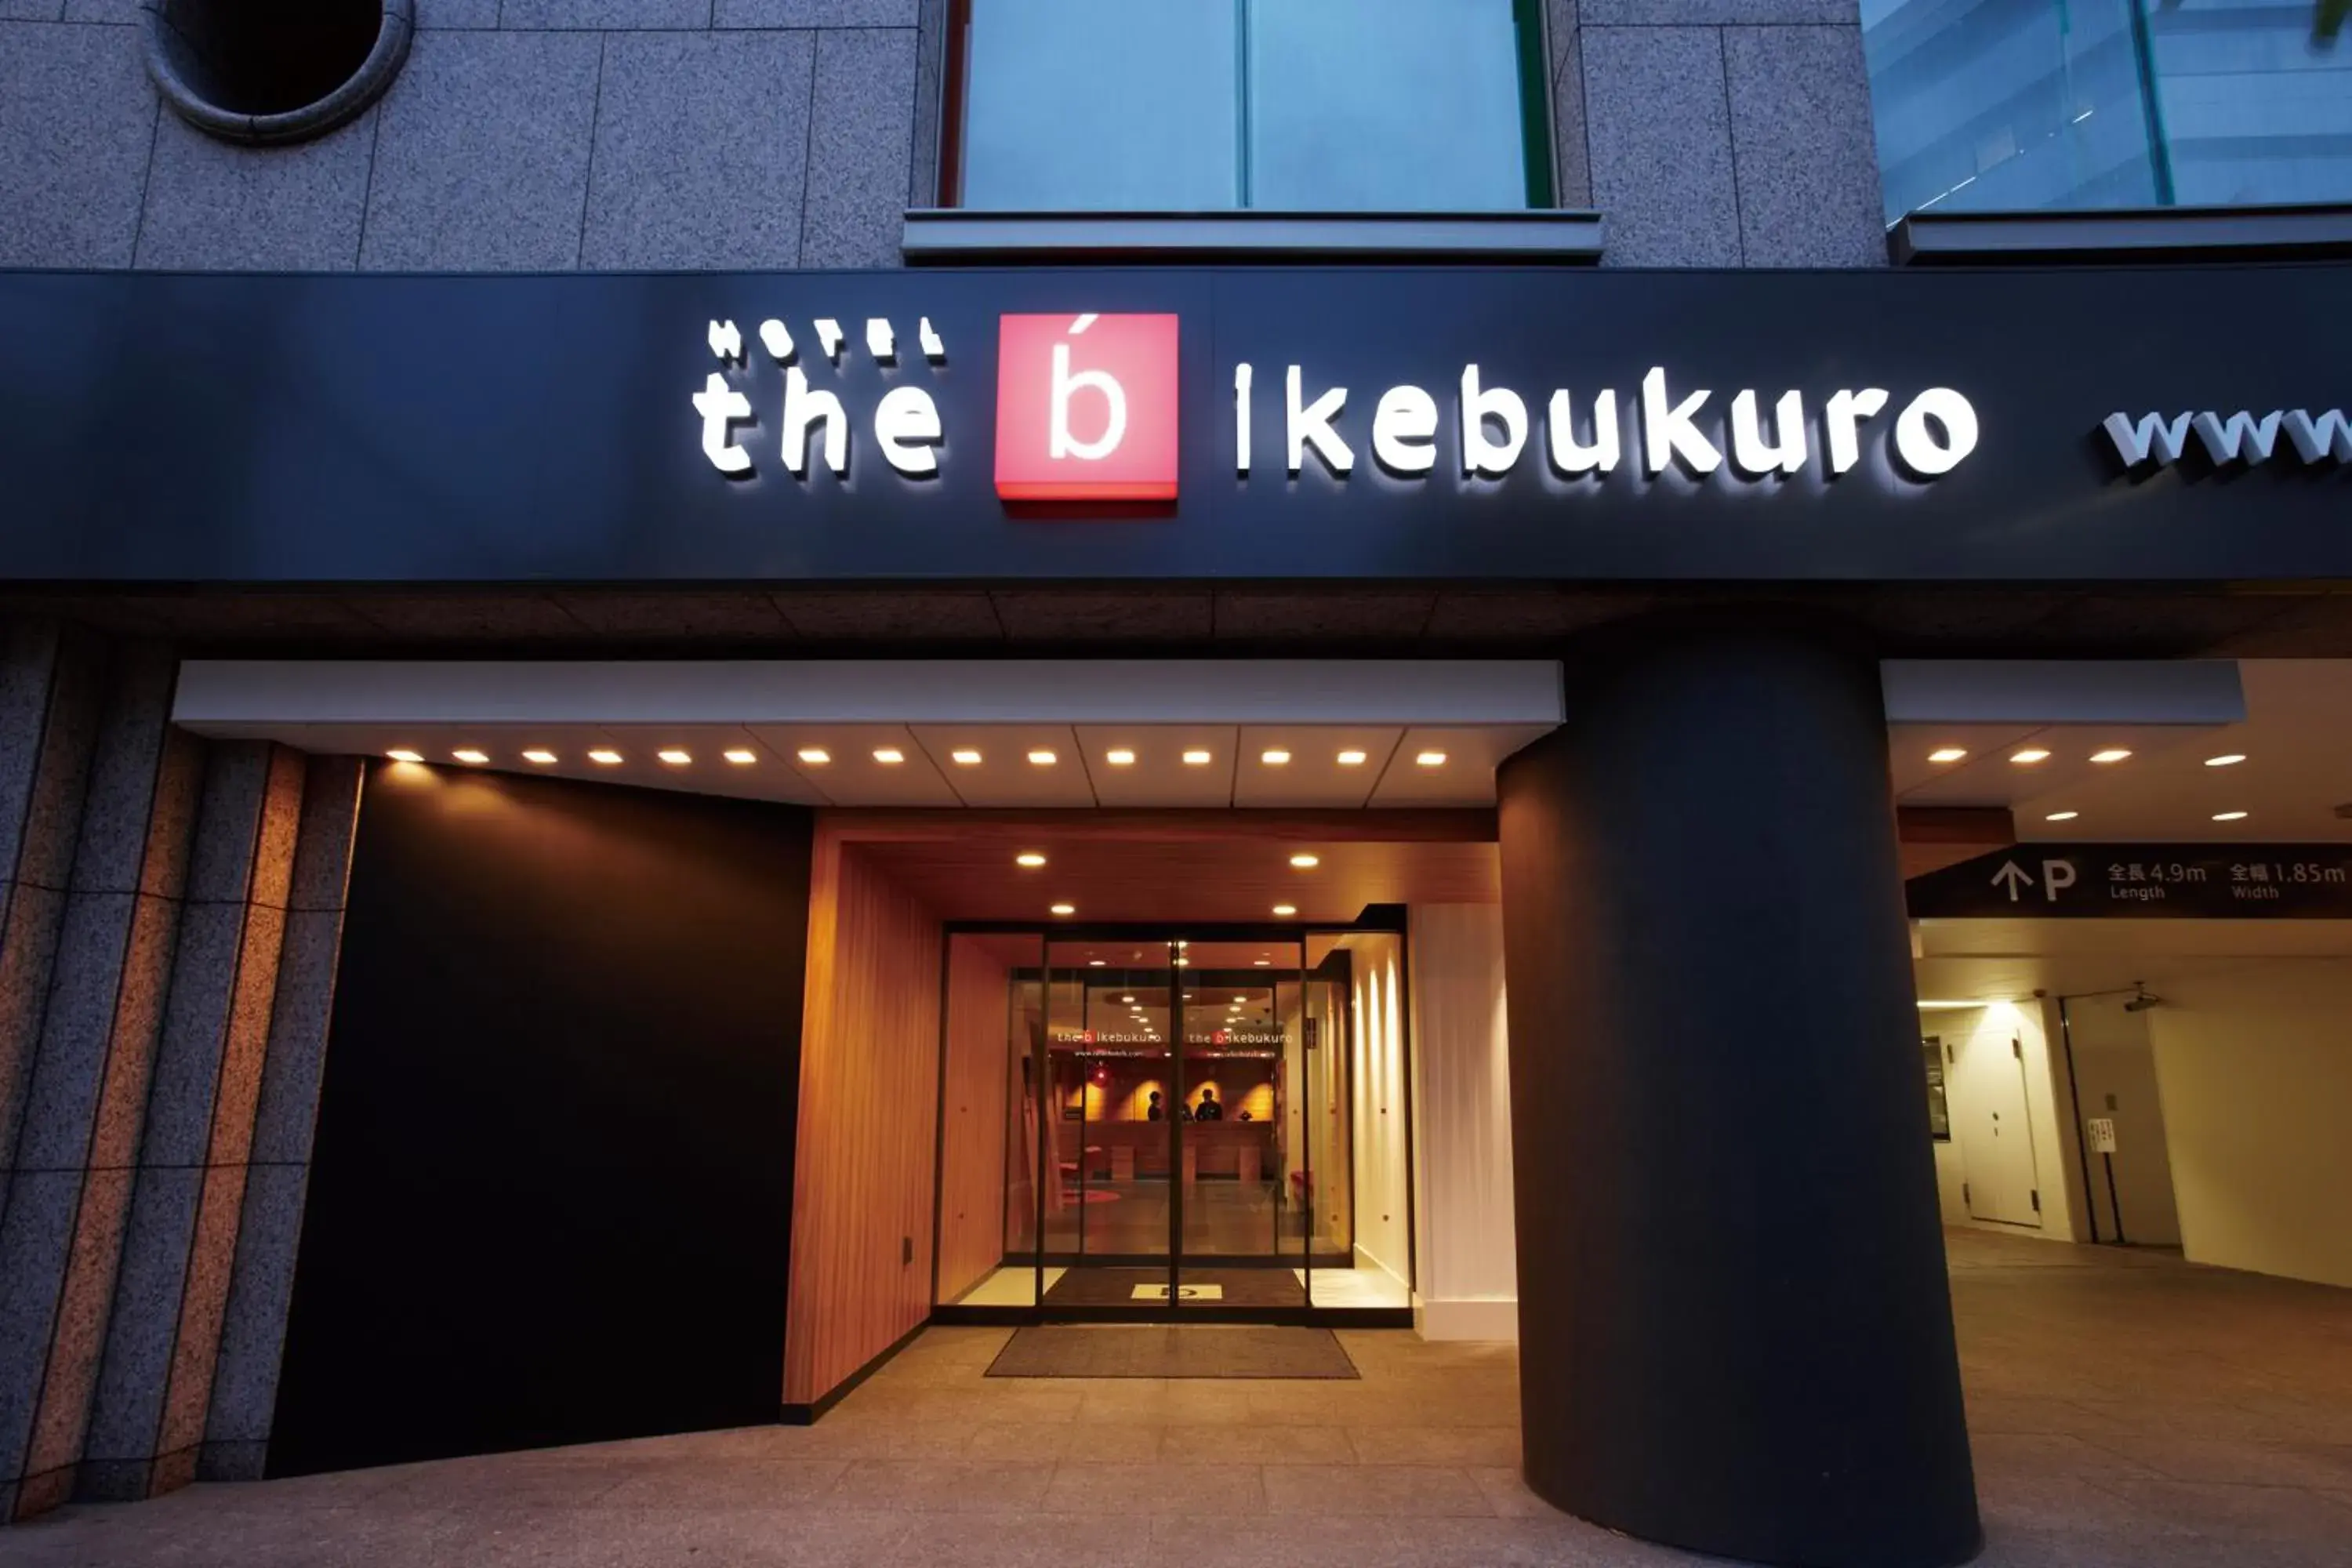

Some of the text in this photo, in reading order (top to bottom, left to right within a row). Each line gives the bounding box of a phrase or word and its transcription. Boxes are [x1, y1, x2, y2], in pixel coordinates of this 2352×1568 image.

[708, 317, 945, 359] HOTEL
[692, 367, 942, 472] the
[1235, 363, 1979, 474] Ikebukuro
[2042, 860, 2077, 902] P
[2107, 863, 2207, 883] 全長 4.9m
[2274, 863, 2346, 883] 1.85m
[2111, 885, 2165, 901] Length
[2232, 885, 2280, 899] Width
[1058, 1033, 1081, 1042] the
[1189, 1033, 1211, 1044] the
